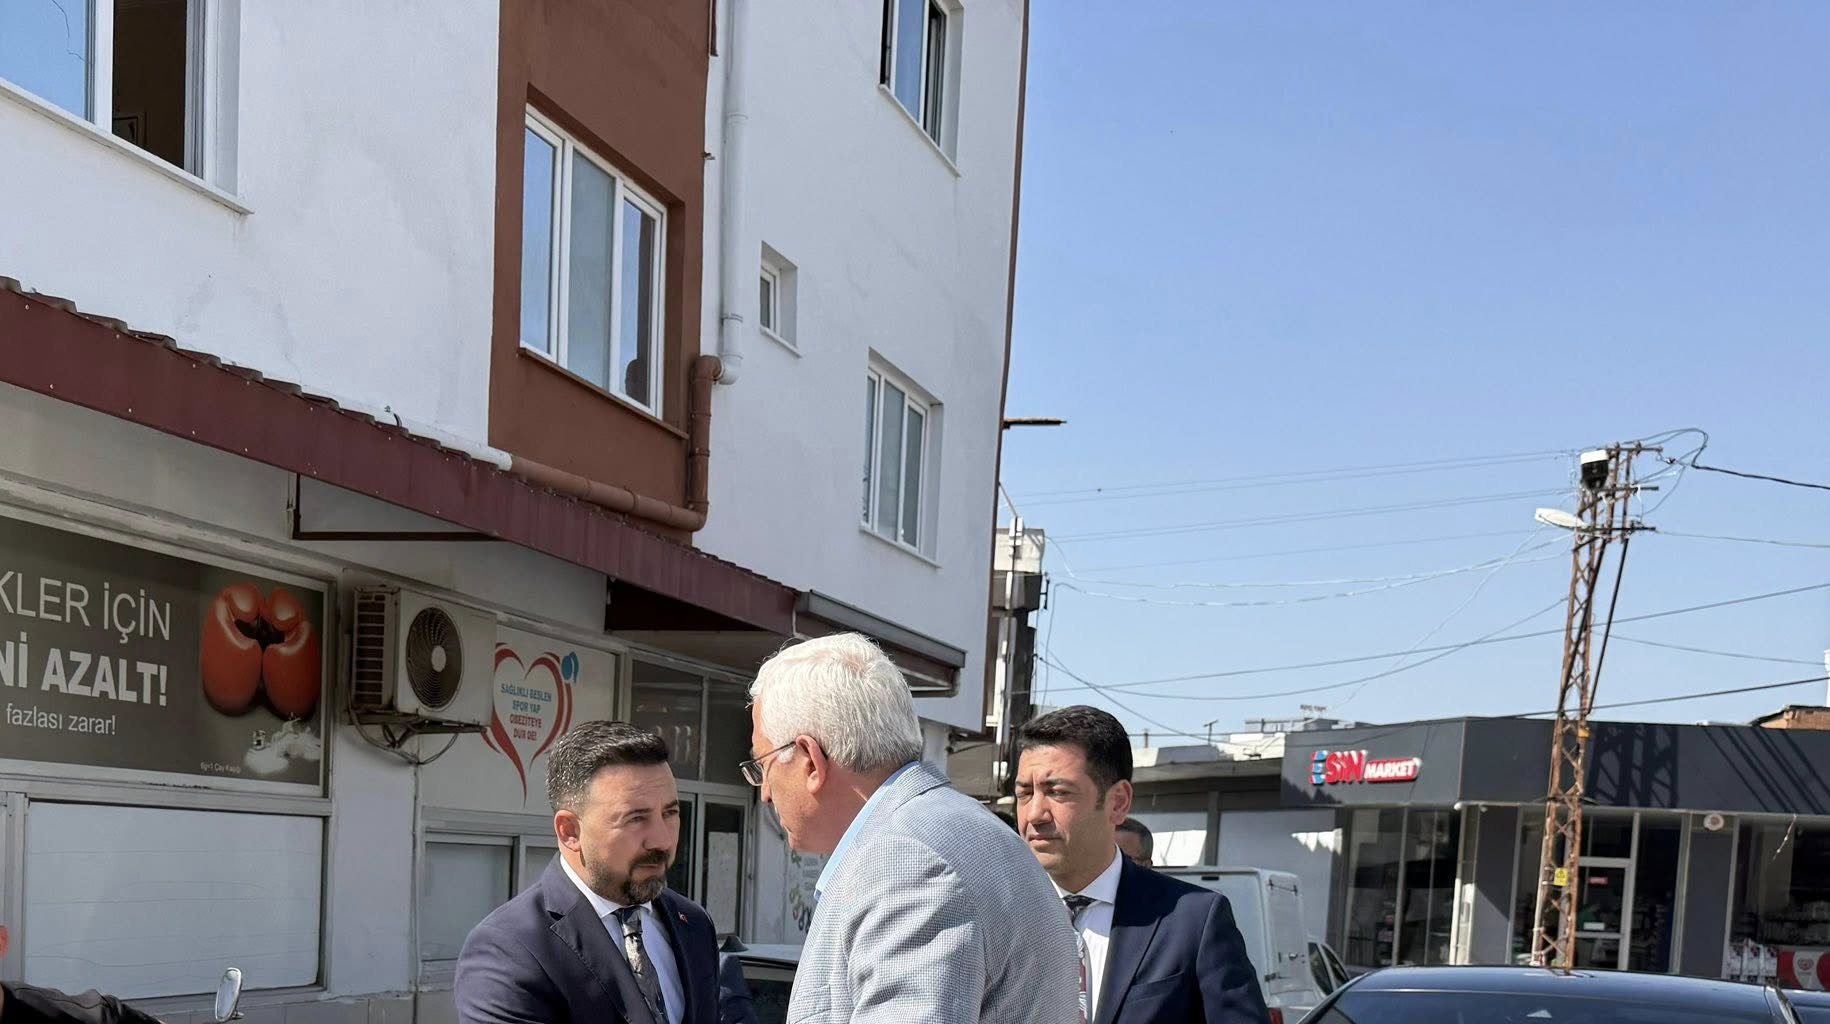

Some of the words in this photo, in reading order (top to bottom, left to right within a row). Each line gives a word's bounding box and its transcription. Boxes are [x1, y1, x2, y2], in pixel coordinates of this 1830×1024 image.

[103, 582, 170, 644] İÇİN
[40, 648, 168, 707] AZALT!
[6, 703, 63, 730] fazlası
[68, 714, 116, 736] zarar!
[512, 700, 529, 712] SPOR
[530, 703, 541, 713] YAP
[1363, 760, 1416, 779] MARKET
